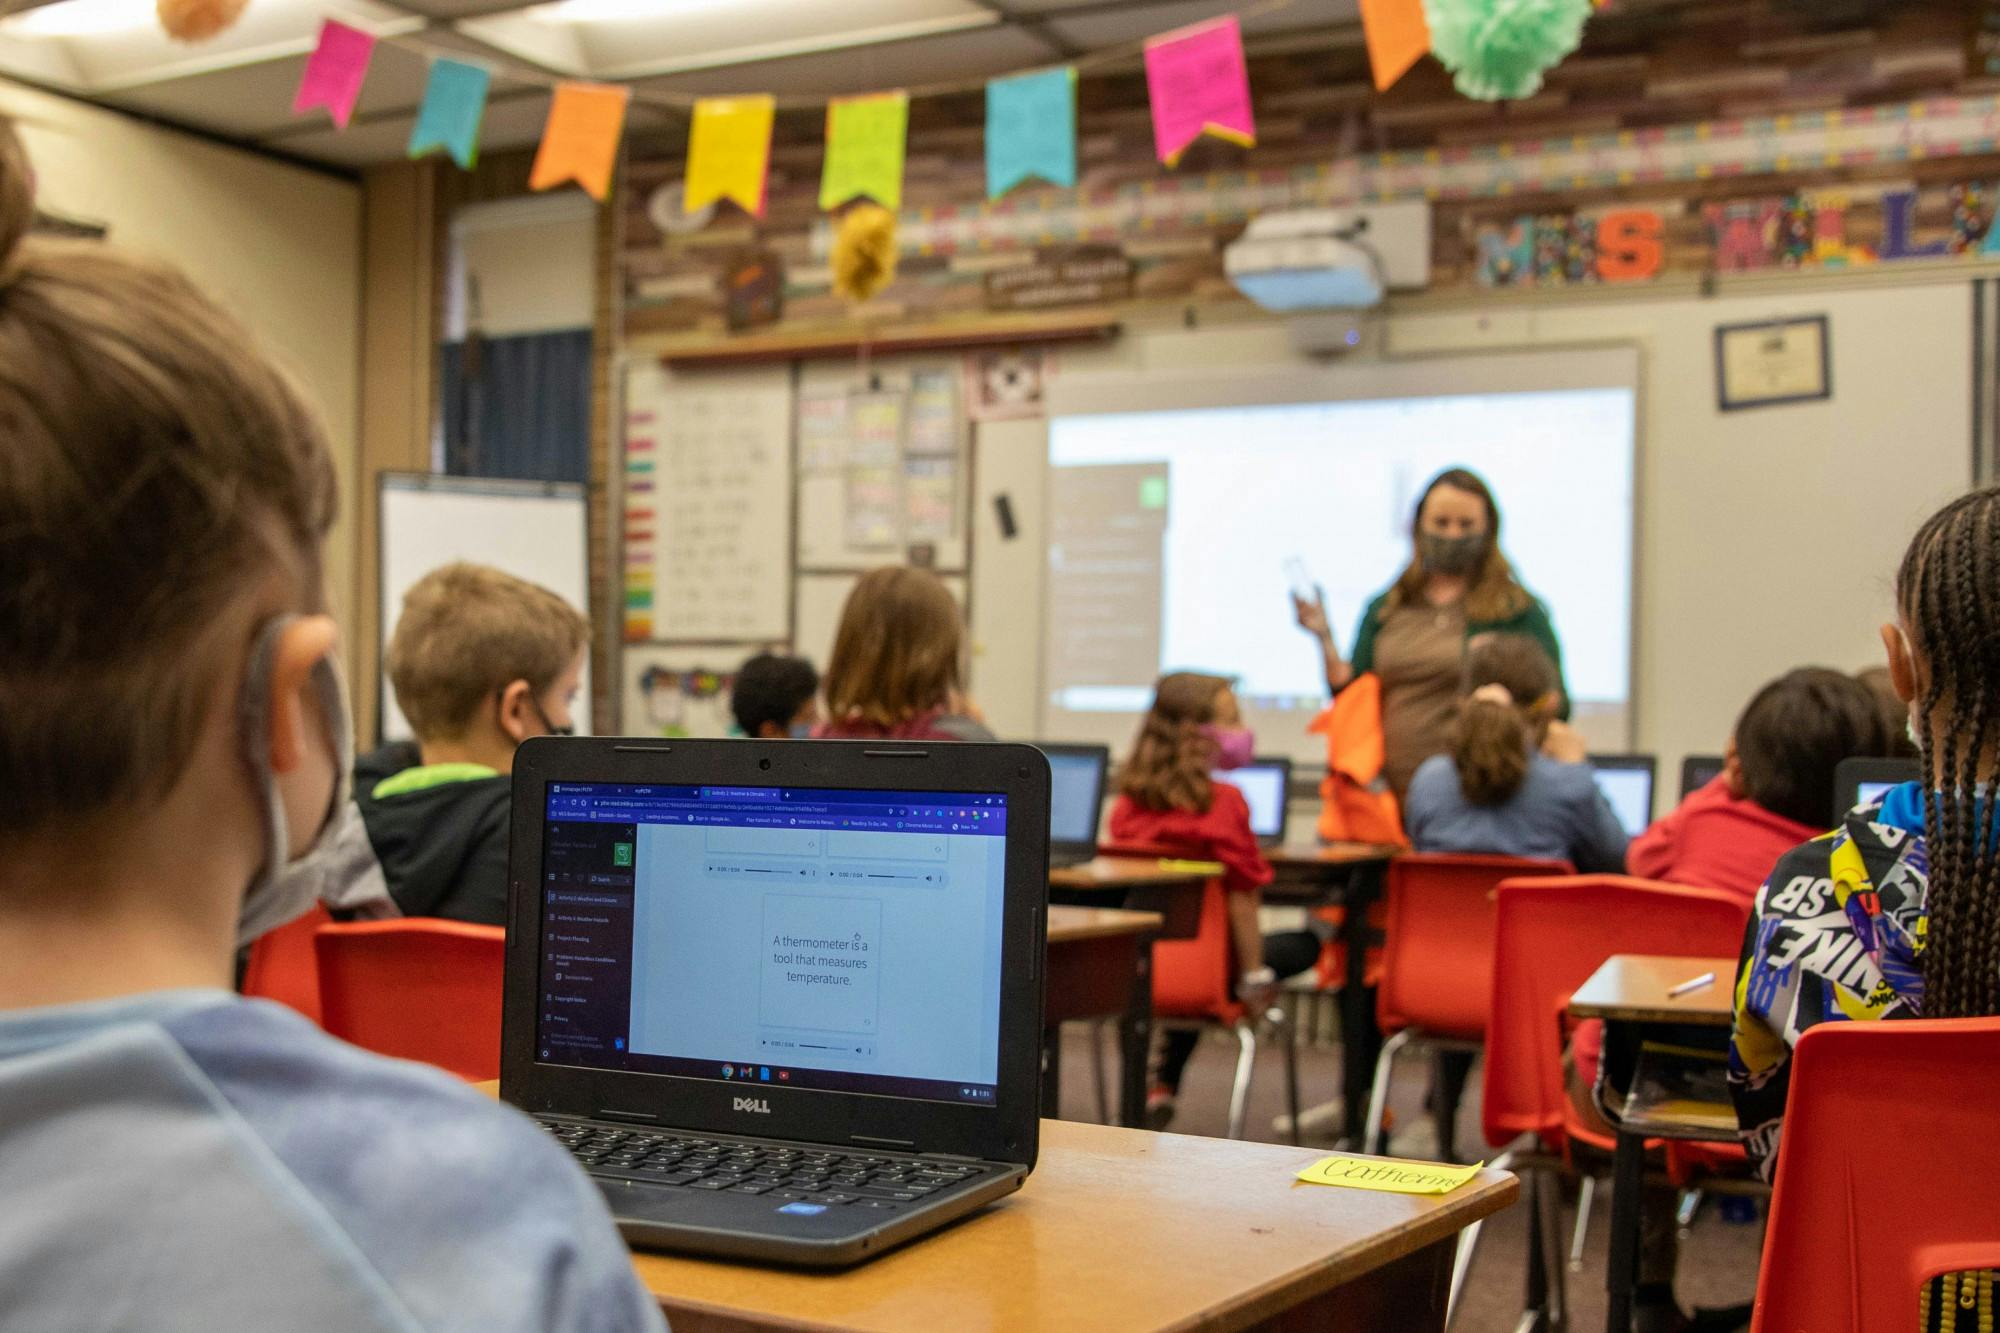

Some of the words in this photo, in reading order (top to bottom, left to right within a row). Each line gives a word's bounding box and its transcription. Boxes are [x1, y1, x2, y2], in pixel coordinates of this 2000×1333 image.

[1770, 875, 1834, 918] SB
[773, 935, 780, 946] A
[782, 936, 849, 950] thermometer
[851, 941, 860, 952] is
[861, 943, 868, 951] a
[773, 953, 793, 964] tool
[795, 954, 816, 966] that
[817, 957, 868, 969] measures
[1766, 918, 1884, 1001] NIKE
[787, 971, 852, 986] temperature.
[733, 1097, 771, 1114] DELL
